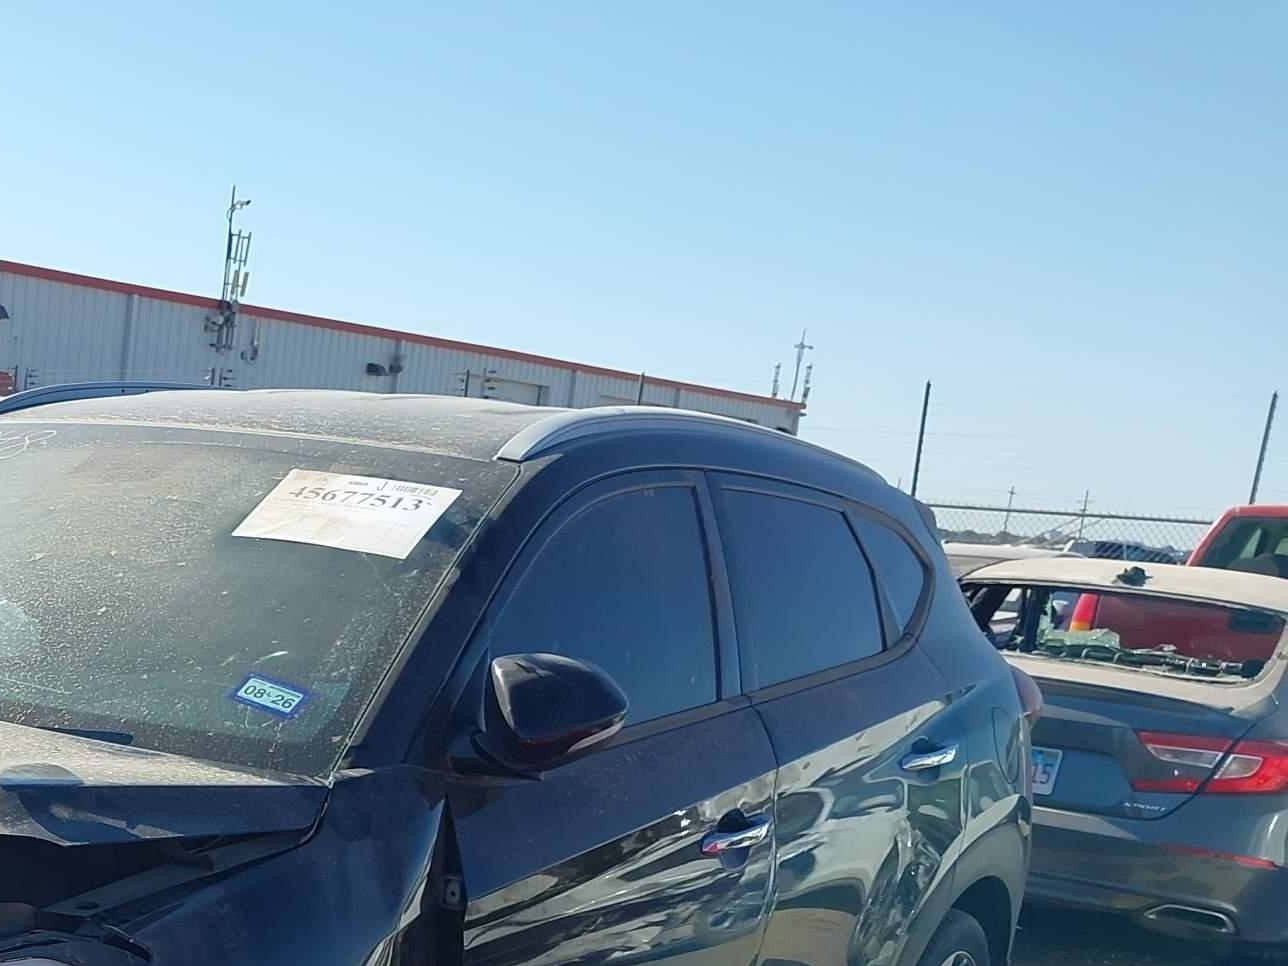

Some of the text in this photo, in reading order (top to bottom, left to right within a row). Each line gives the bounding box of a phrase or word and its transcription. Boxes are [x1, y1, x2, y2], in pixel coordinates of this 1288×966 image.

[288, 486, 424, 512] 45677513
[243, 685, 267, 699] 08
[270, 694, 296, 709] 26
